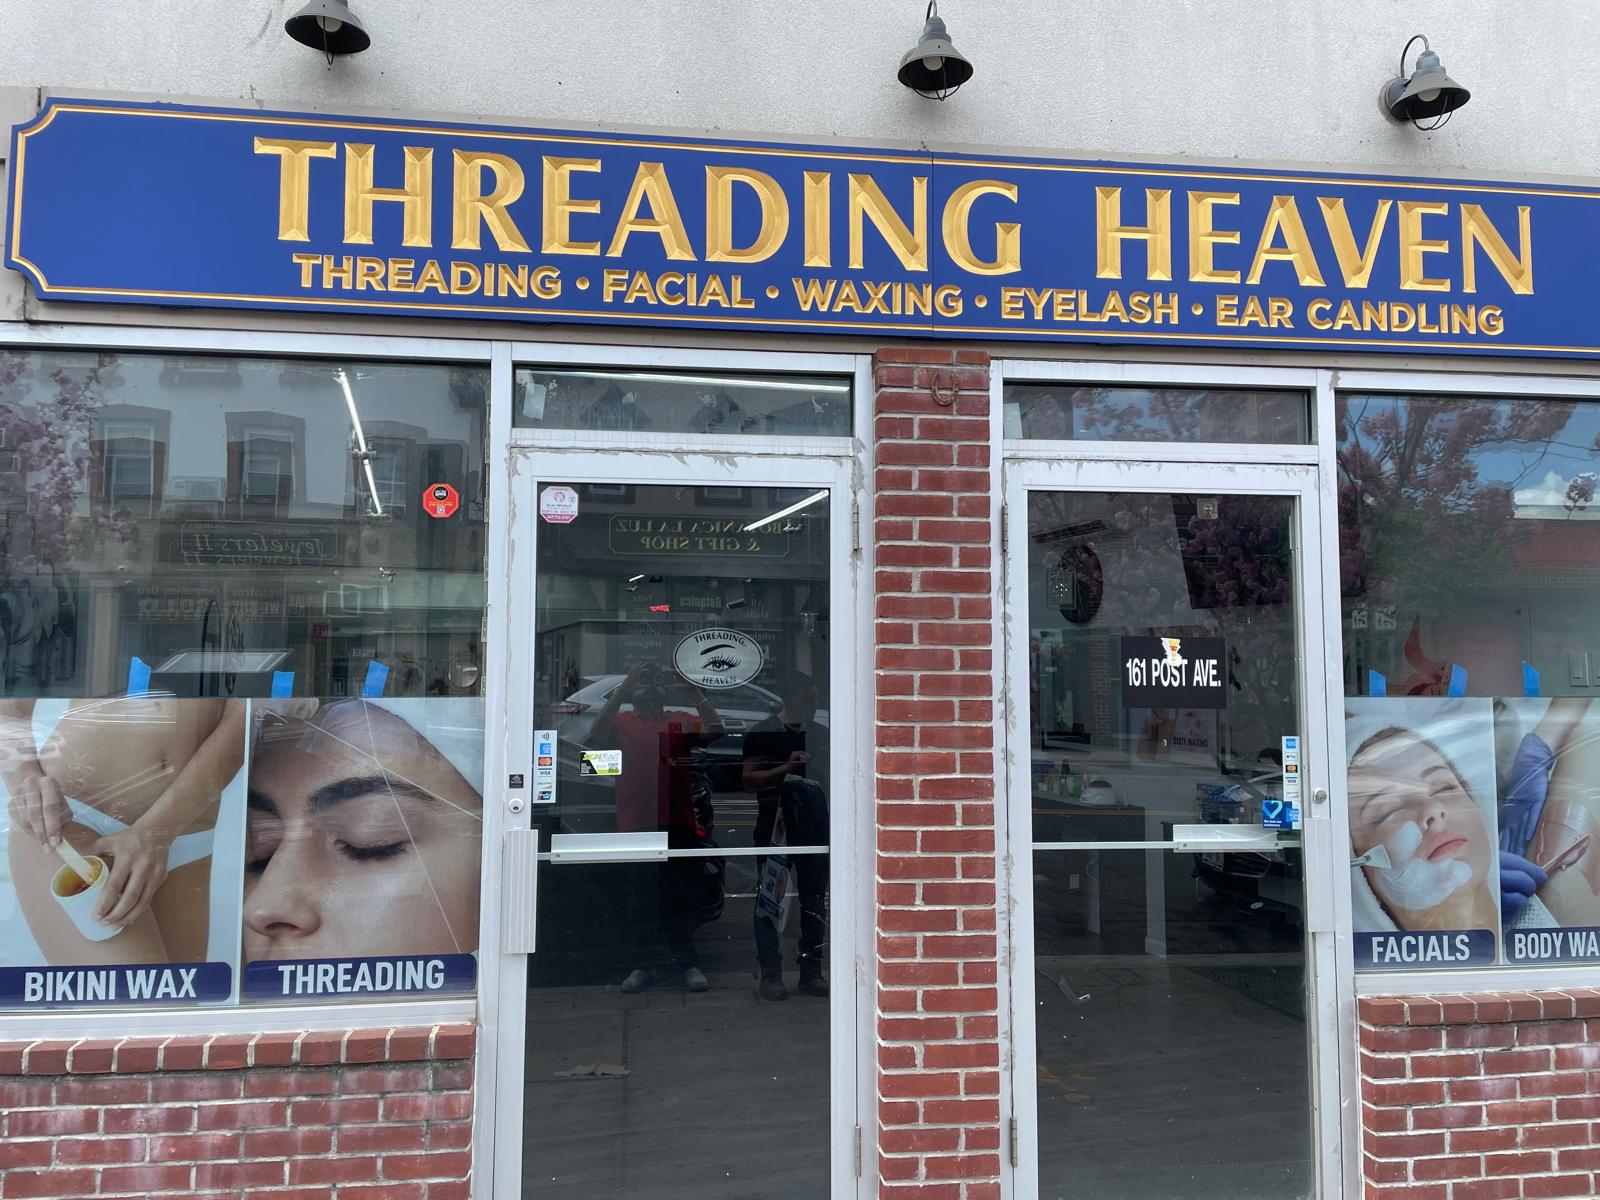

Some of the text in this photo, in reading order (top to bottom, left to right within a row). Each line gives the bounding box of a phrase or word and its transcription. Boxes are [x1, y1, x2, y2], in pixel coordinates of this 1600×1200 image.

[254, 137, 1535, 296] THREADING HEAVEN
[293, 254, 1505, 336] THREADING FACIAL WAXING EYELASH EAR CANDLING
[693, 632, 746, 647] THREADING
[702, 675, 737, 685] HEAVEN
[1126, 657, 1222, 688] 161 POST AVE.
[1372, 934, 1470, 964] FACIALS
[1514, 931, 1600, 960] BODY WA
[25, 968, 197, 1002] BIKINI WAX
[278, 959, 446, 995] THREADING
